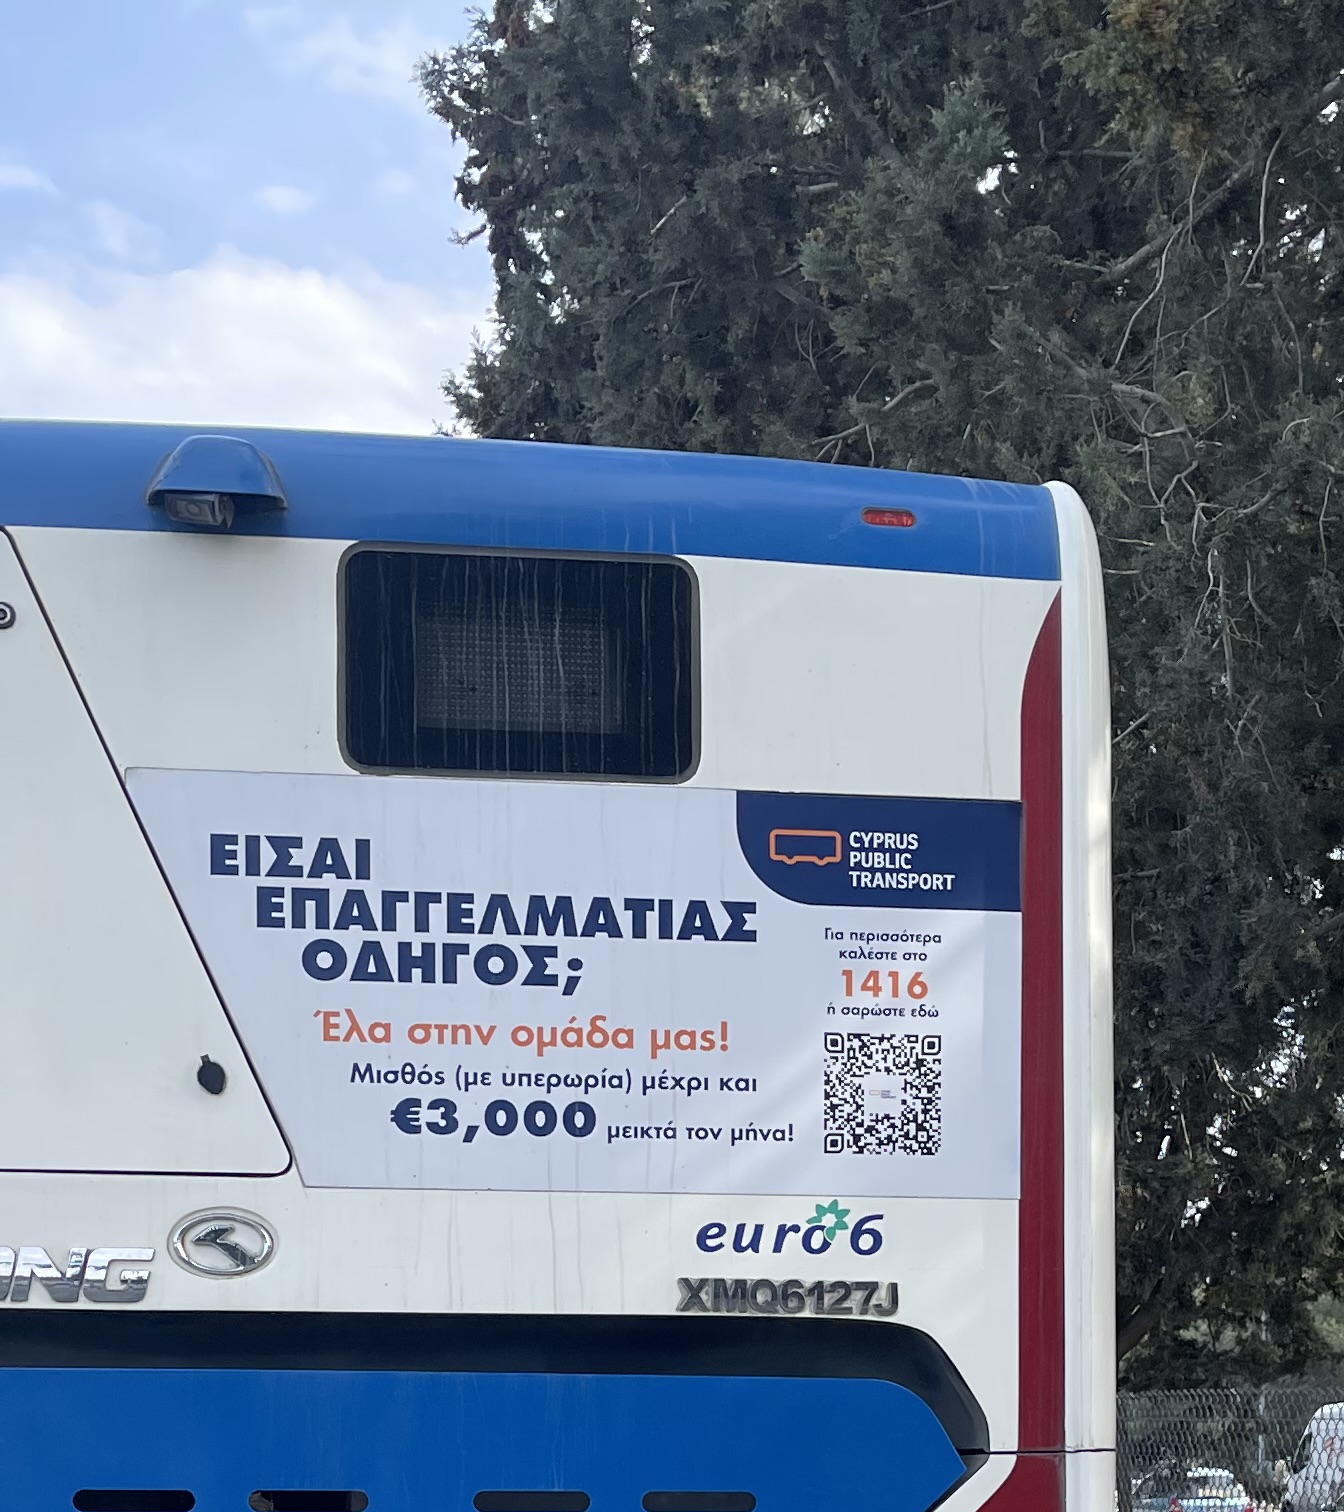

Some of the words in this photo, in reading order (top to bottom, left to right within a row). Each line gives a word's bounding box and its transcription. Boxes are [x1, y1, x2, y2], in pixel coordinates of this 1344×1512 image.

[209, 833, 371, 880] ΕΙΣΑΙ
[849, 831, 919, 850] CYPRUS
[849, 851, 912, 869] PUBLIC
[849, 871, 956, 890] TRANSPORT
[256, 886, 757, 942] ΕΠΑΓΓΕΛΜΑΤΙΑΣ
[824, 927, 844, 940] Για
[850, 929, 942, 946] περισσότερα
[301, 938, 584, 996] ΟΔΗΓΟΣ;
[839, 946, 897, 961] καλέστε
[902, 952, 928, 961] στο
[841, 969, 928, 1000] 1416
[827, 1002, 836, 1015] ή
[841, 1003, 906, 1020] σαρώστε
[911, 1004, 939, 1018] εδώ
[313, 1008, 391, 1044] Έλα
[407, 1021, 497, 1046] στην
[510, 1015, 634, 1056] ομάδα
[650, 1021, 729, 1059] μας!
[350, 1062, 445, 1087] Μισθός
[455, 1064, 492, 1092] (με
[502, 1068, 633, 1096] υπερωρία)
[641, 1069, 709, 1097] μέχρι
[719, 1075, 758, 1093] και
[390, 1097, 597, 1143] €3,000
[607, 1122, 677, 1144] μεικτά
[686, 1126, 723, 1141] τον
[730, 1123, 794, 1146] μήνα!
[676, 1277, 899, 1317] XMQ6127J
